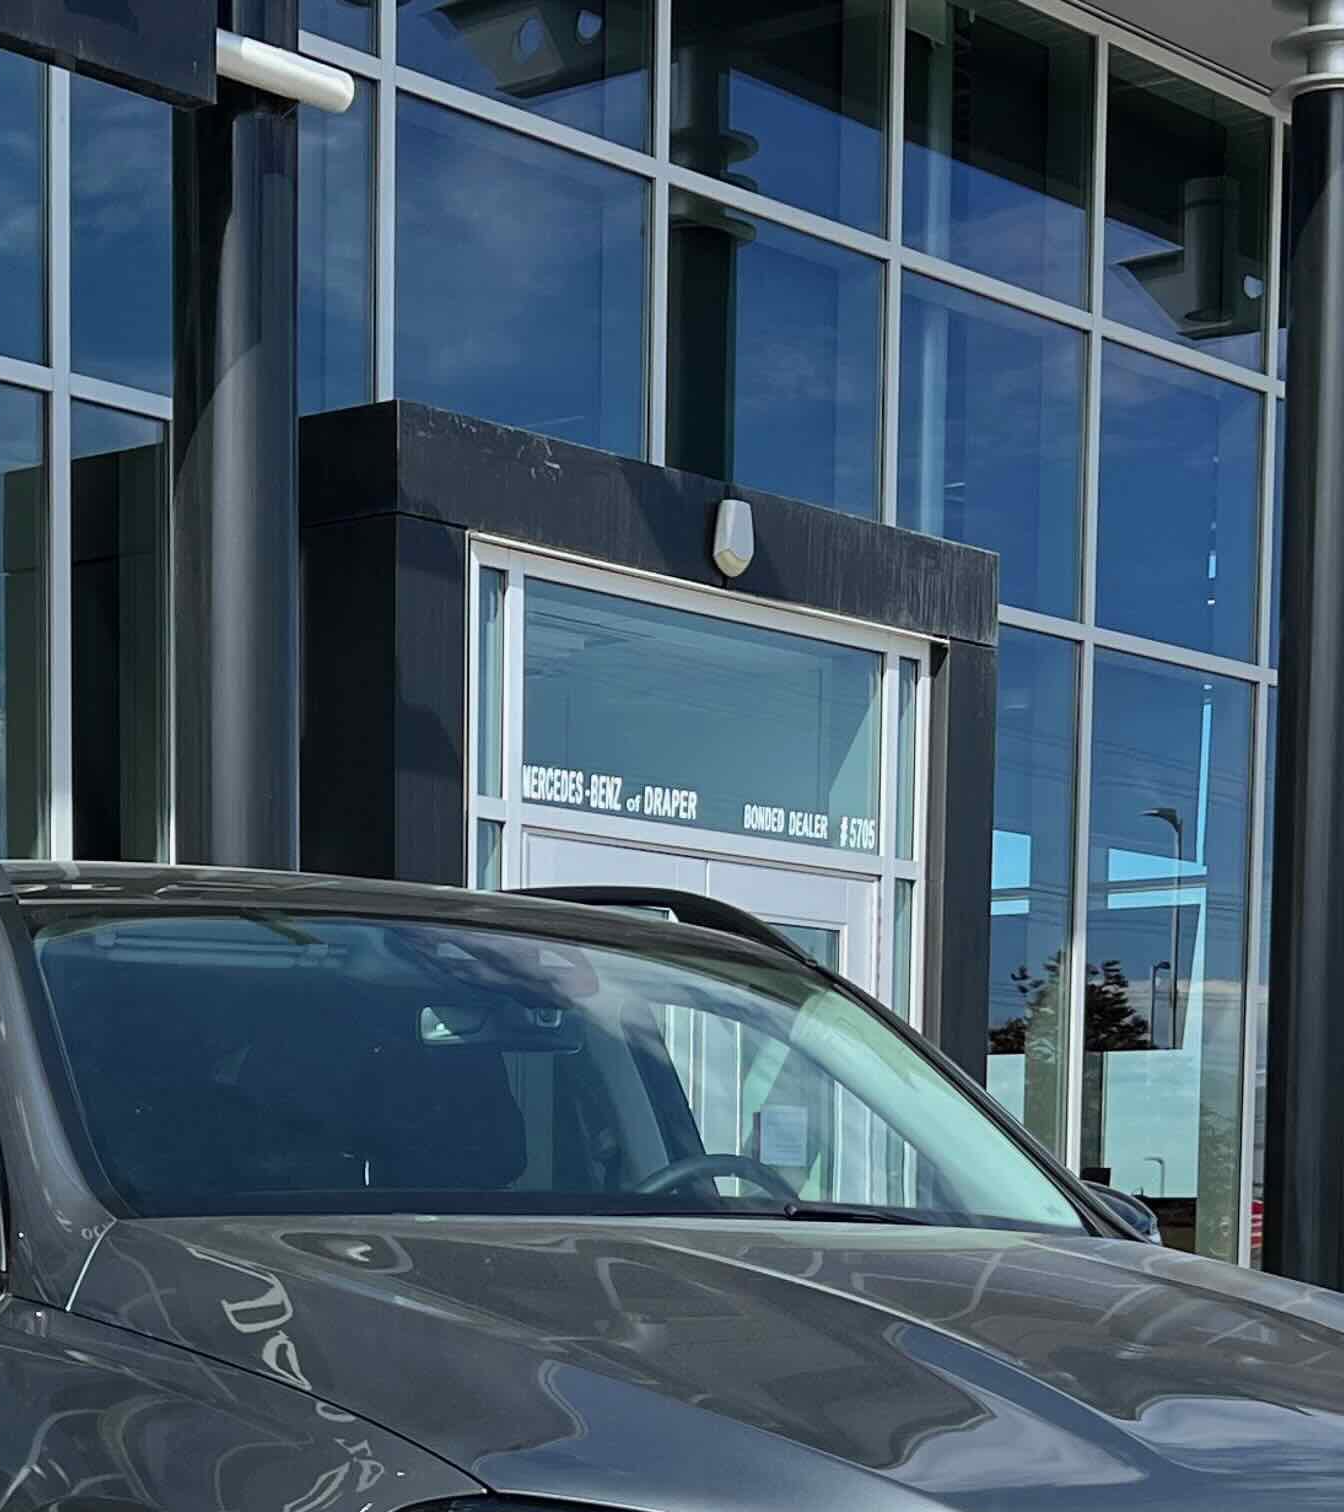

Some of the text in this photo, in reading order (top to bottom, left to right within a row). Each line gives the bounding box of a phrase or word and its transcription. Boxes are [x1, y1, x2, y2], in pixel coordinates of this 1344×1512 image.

[523, 765, 698, 820] MERCEDES-BENZ of DRAPER
[744, 803, 876, 849] BONDED DEALER #5705
